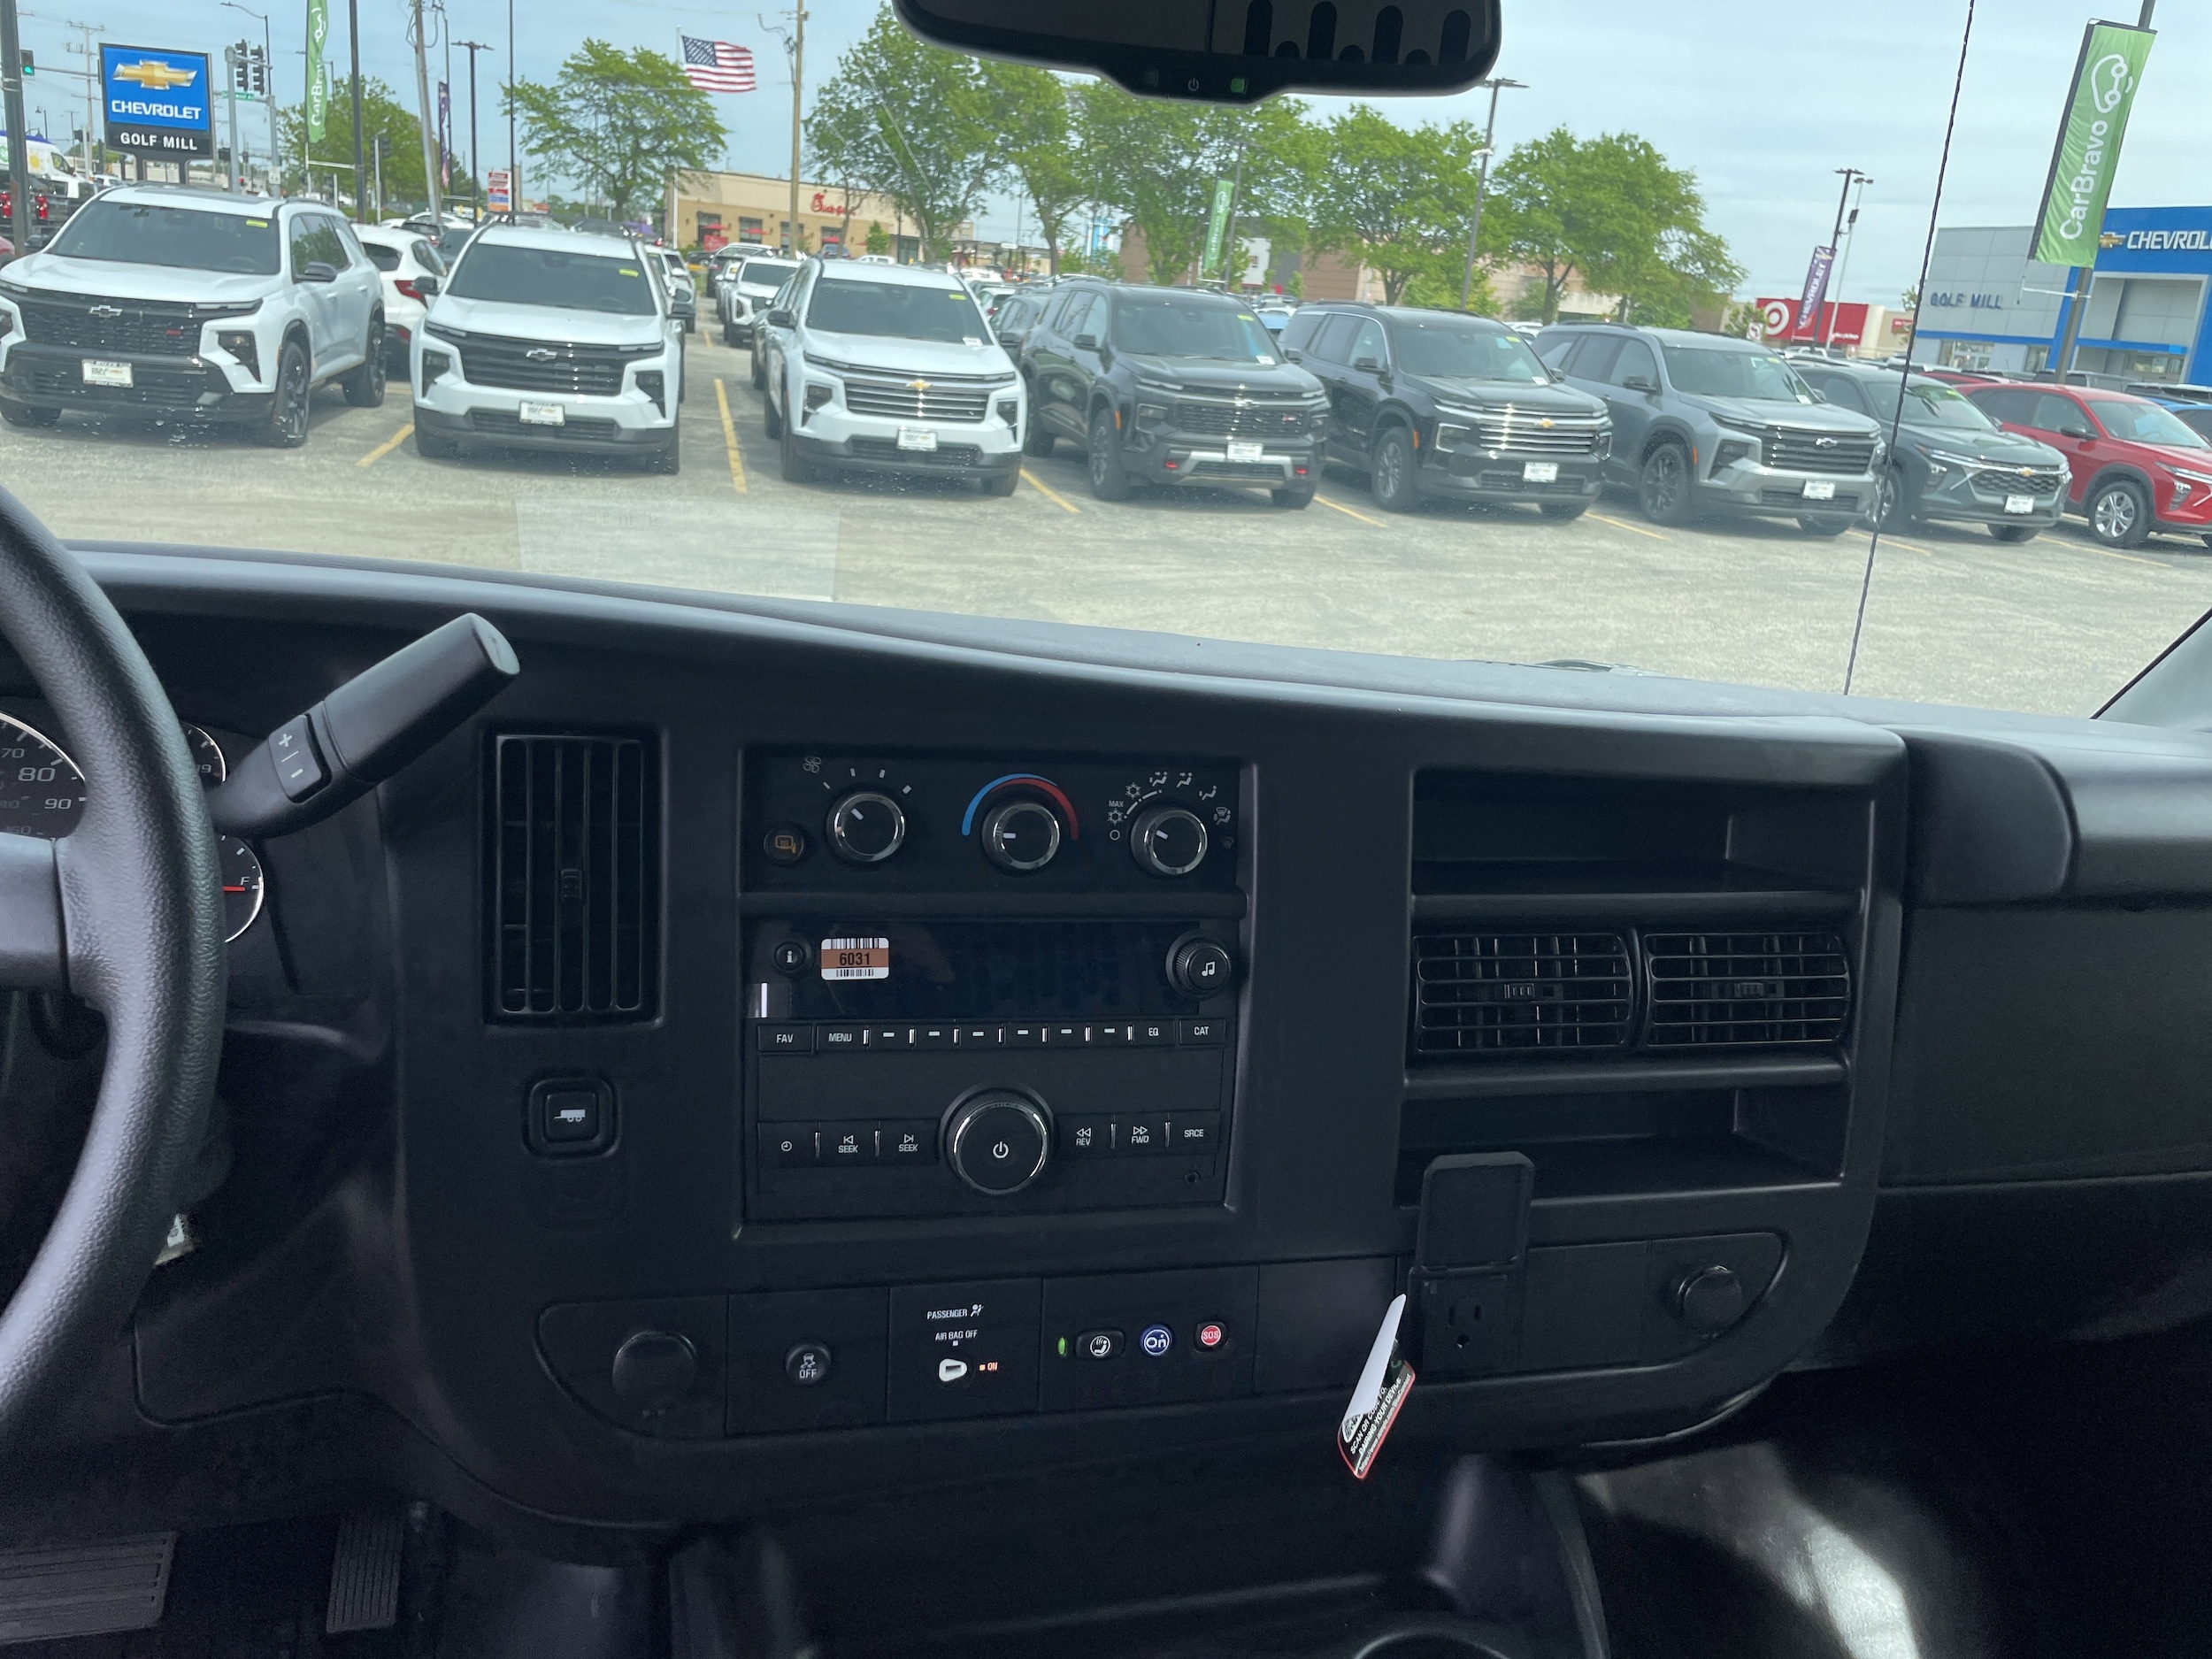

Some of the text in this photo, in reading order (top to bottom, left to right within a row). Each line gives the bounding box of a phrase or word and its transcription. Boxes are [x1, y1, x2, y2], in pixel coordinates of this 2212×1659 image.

[311, 56, 323, 126] CarBrav
[111, 99, 202, 120] CHEVROLET
[120, 132, 198, 150] GOLF MILL
[2059, 119, 2108, 241] CarBravo
[2126, 230, 2212, 250] CHEVROL
[1930, 292, 2001, 310] GOLF MILL
[1, 748, 25, 759] 70
[18, 766, 56, 782] 80
[44, 798, 73, 810] 90
[1108, 800, 1125, 810] MAX
[240, 876, 250, 886] F
[839, 952, 871, 965] 6031
[1148, 1026, 1160, 1037] EQ
[1194, 1025, 1210, 1036] CAT
[776, 1033, 794, 1044] FAV
[828, 1033, 853, 1043] MENU
[1184, 1128, 1204, 1138] SRCE
[1075, 1136, 1092, 1146] REV
[1131, 1134, 1150, 1144] FWD
[838, 1143, 859, 1154] SEEK
[898, 1141, 919, 1152] SEEK
[927, 1309, 968, 1320] PASSENGER
[934, 1329, 979, 1341] AIR BAG OFF
[1202, 1330, 1220, 1340] SOS
[987, 1362, 998, 1371] ON
[799, 1368, 818, 1379] OFF
[1358, 1376, 1402, 1455] PAIRING YOUR DEVICE
[1349, 1430, 1363, 1455] SCAN
